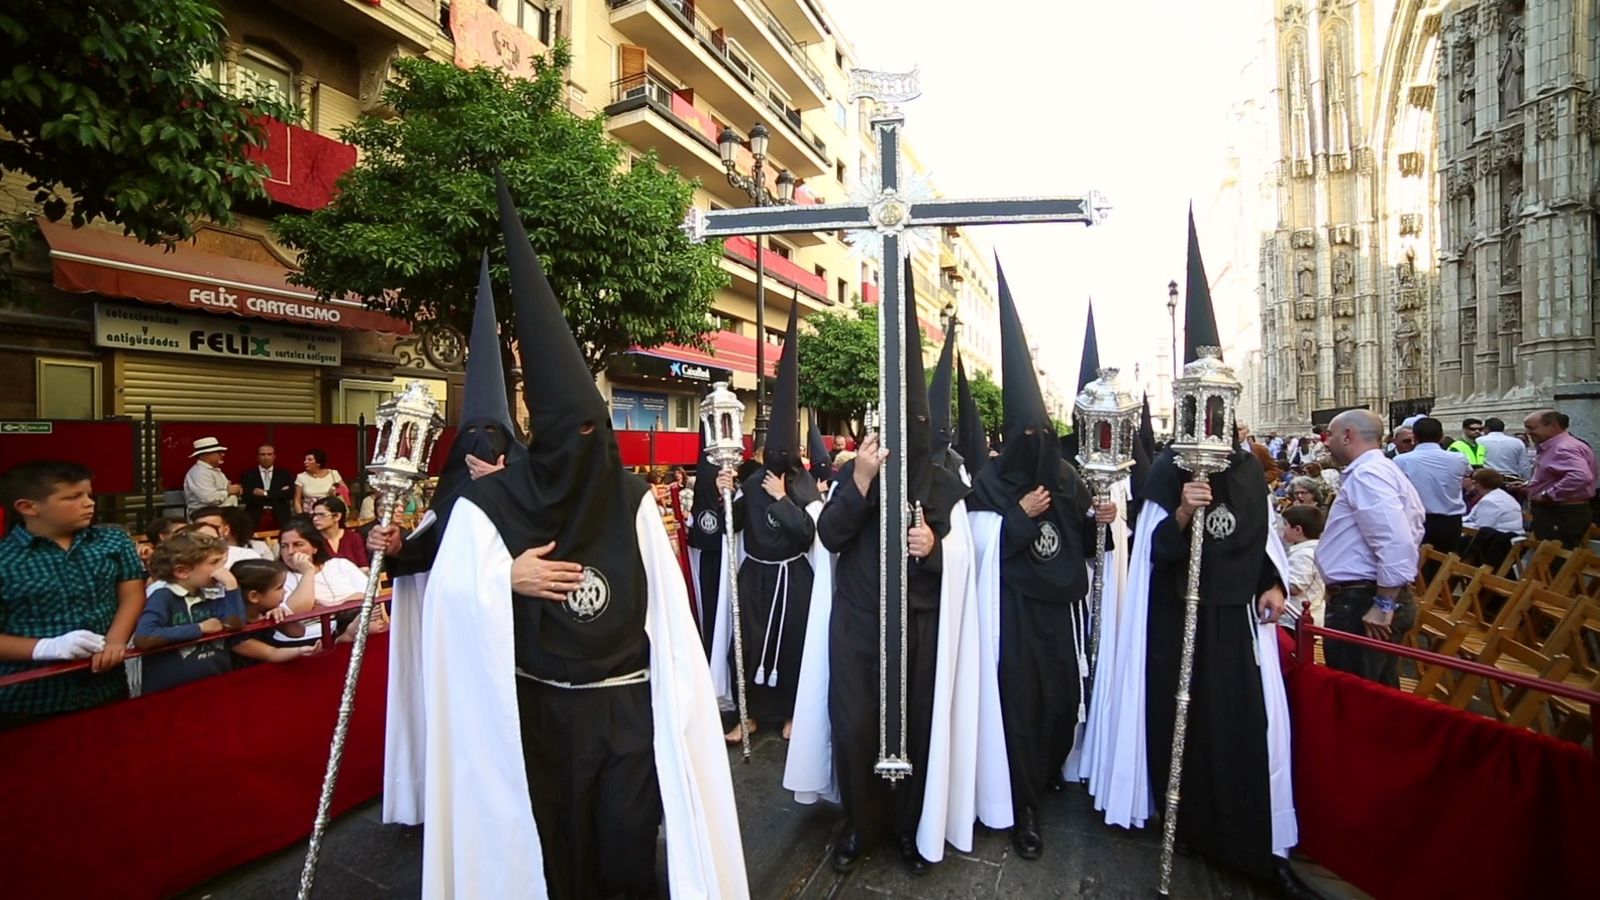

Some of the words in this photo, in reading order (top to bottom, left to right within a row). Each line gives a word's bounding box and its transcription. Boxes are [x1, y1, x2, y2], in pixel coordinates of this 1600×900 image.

[246, 297, 341, 322] CARTELISMO
[106, 331, 180, 348] antigüedades
[275, 349, 305, 359] carteles
[306, 351, 337, 363] antiguos
